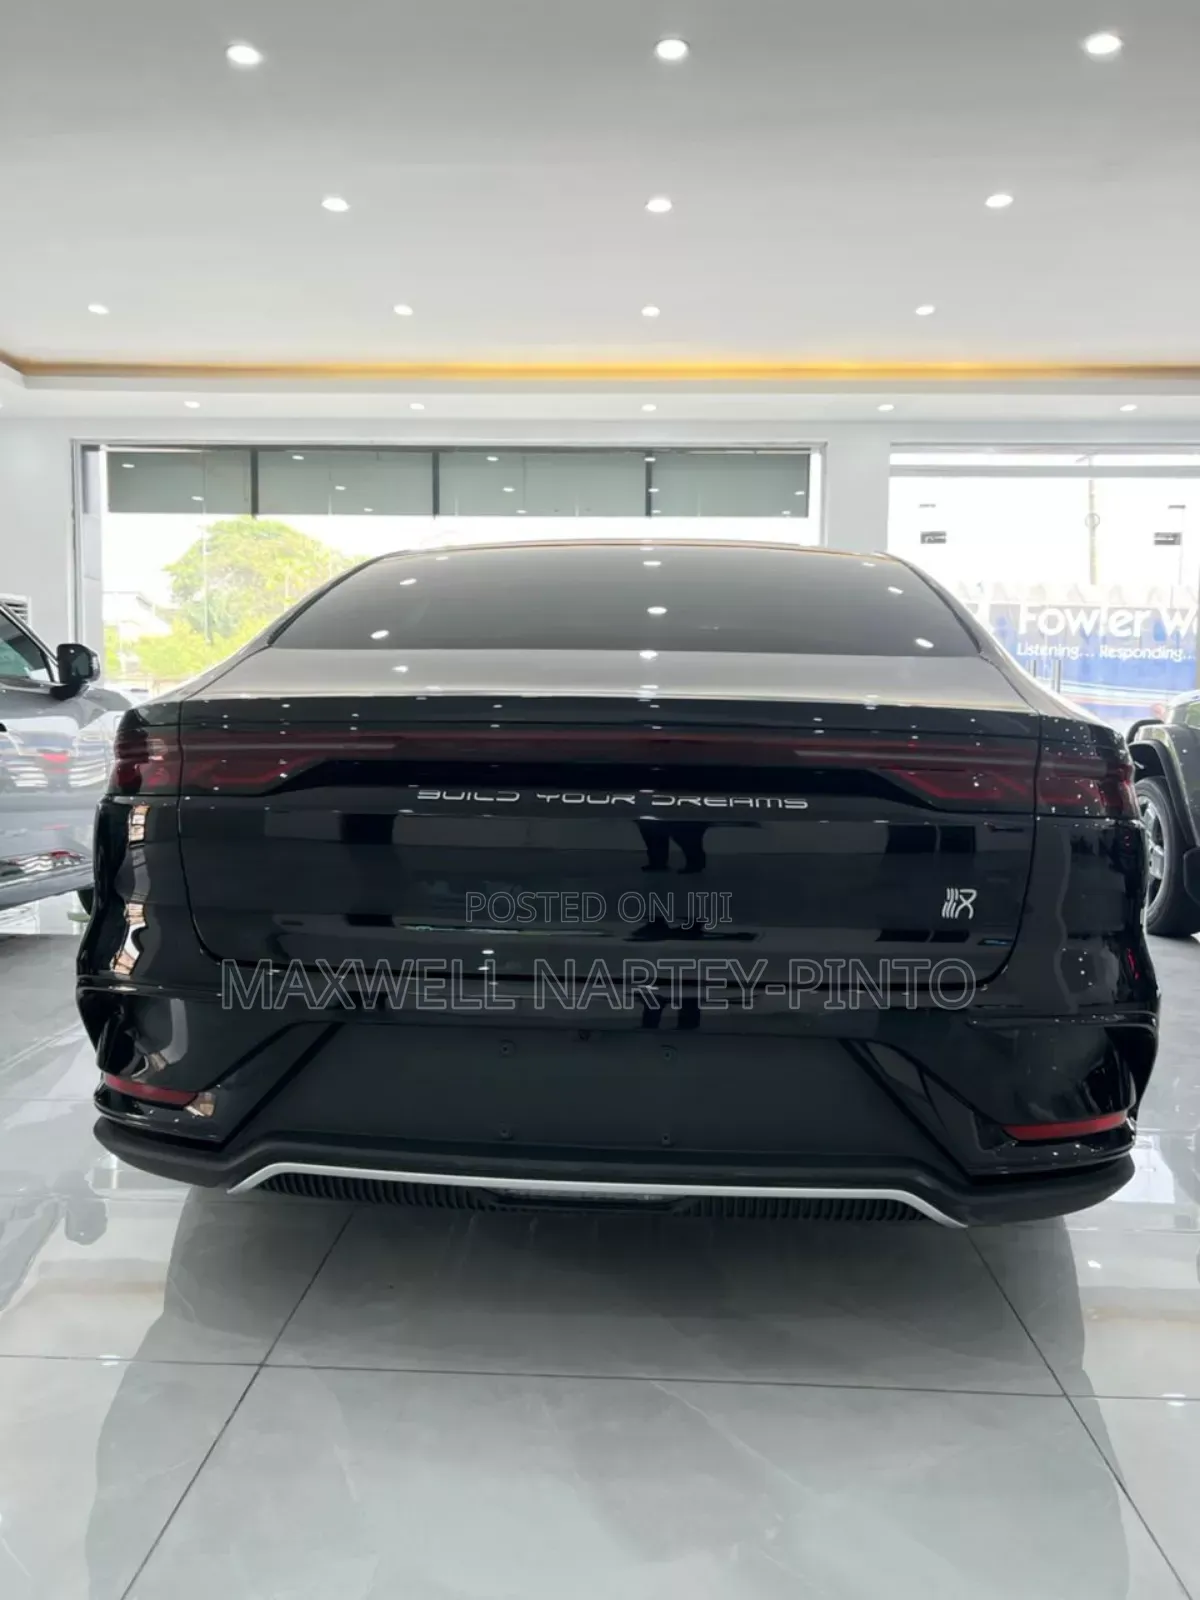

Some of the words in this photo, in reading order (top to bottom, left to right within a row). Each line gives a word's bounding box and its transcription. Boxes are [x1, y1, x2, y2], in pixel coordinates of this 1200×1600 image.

[1018, 601, 1153, 638] Fowler
[1156, 605, 1198, 639] W
[416, 789, 520, 802] BUILD
[536, 792, 636, 805] YOUR
[651, 794, 809, 809] DREAMS
